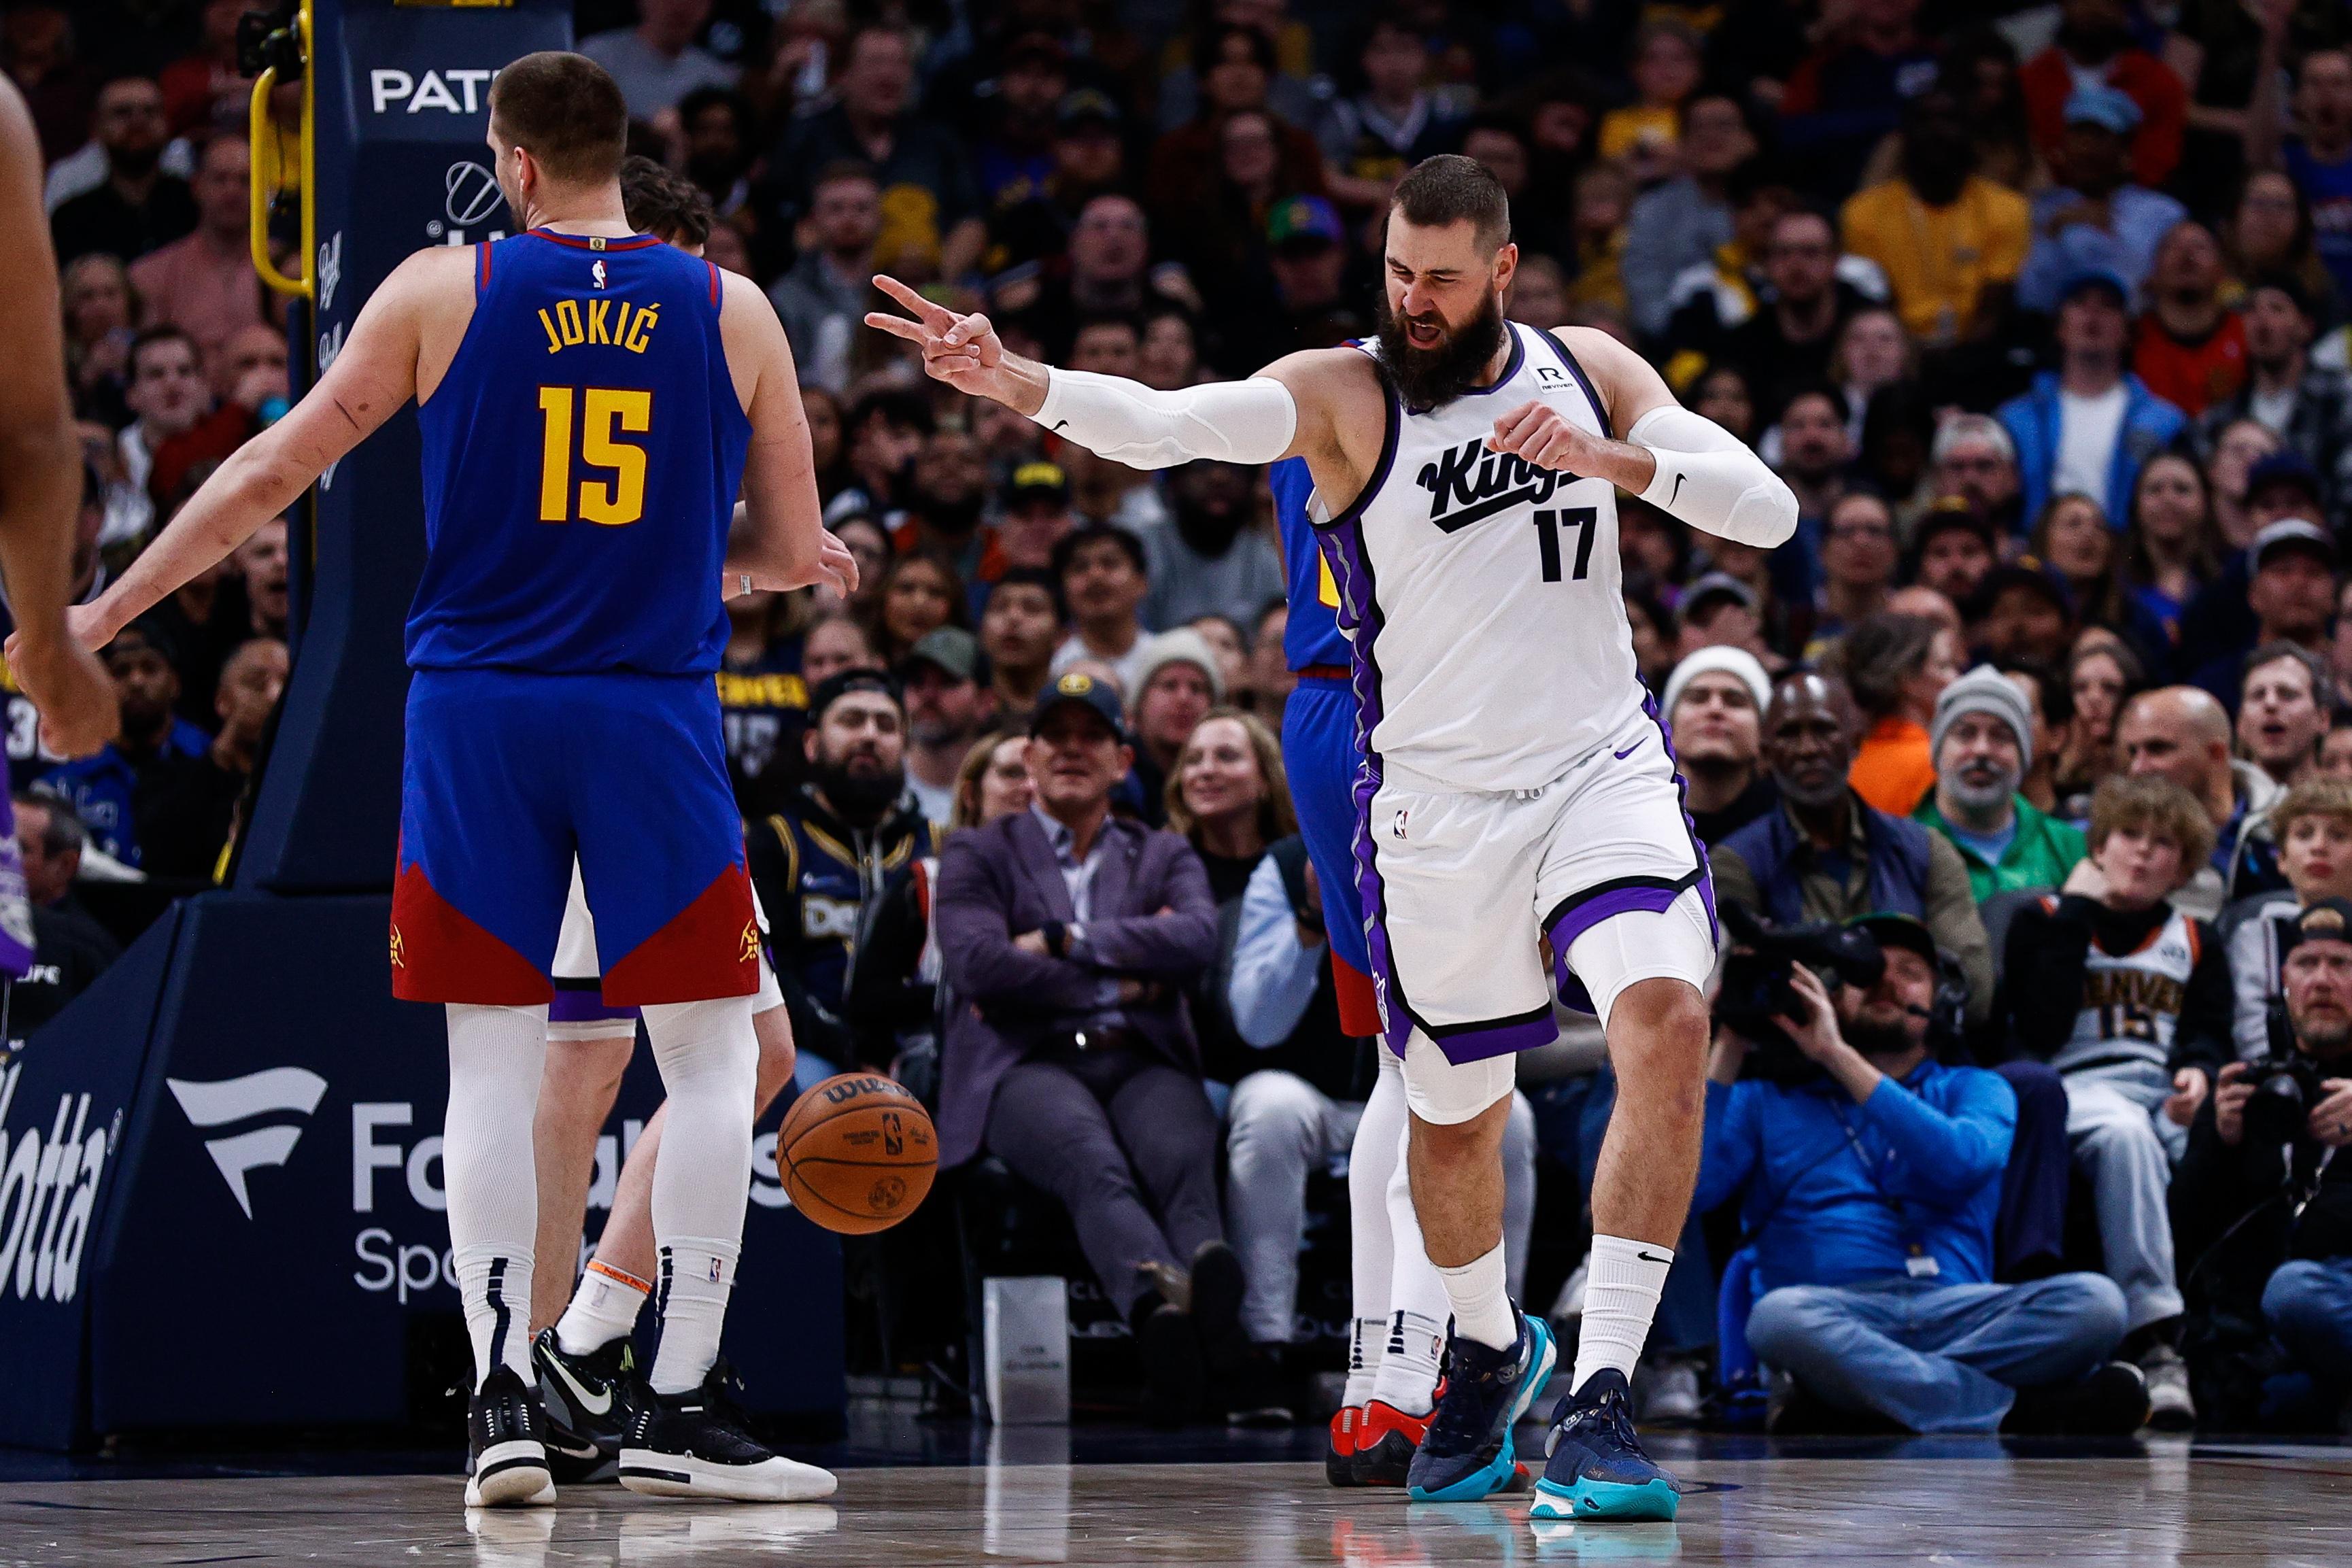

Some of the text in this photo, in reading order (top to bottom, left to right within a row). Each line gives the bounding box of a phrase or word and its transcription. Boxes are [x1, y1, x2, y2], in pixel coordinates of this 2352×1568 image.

[370, 69, 502, 114] PAT
[538, 299, 662, 354] JOKIĆ
[538, 386, 653, 526] 15
[1416, 438, 1572, 522] King
[1533, 507, 1597, 583] 17
[0, 1061, 107, 1303] otta
